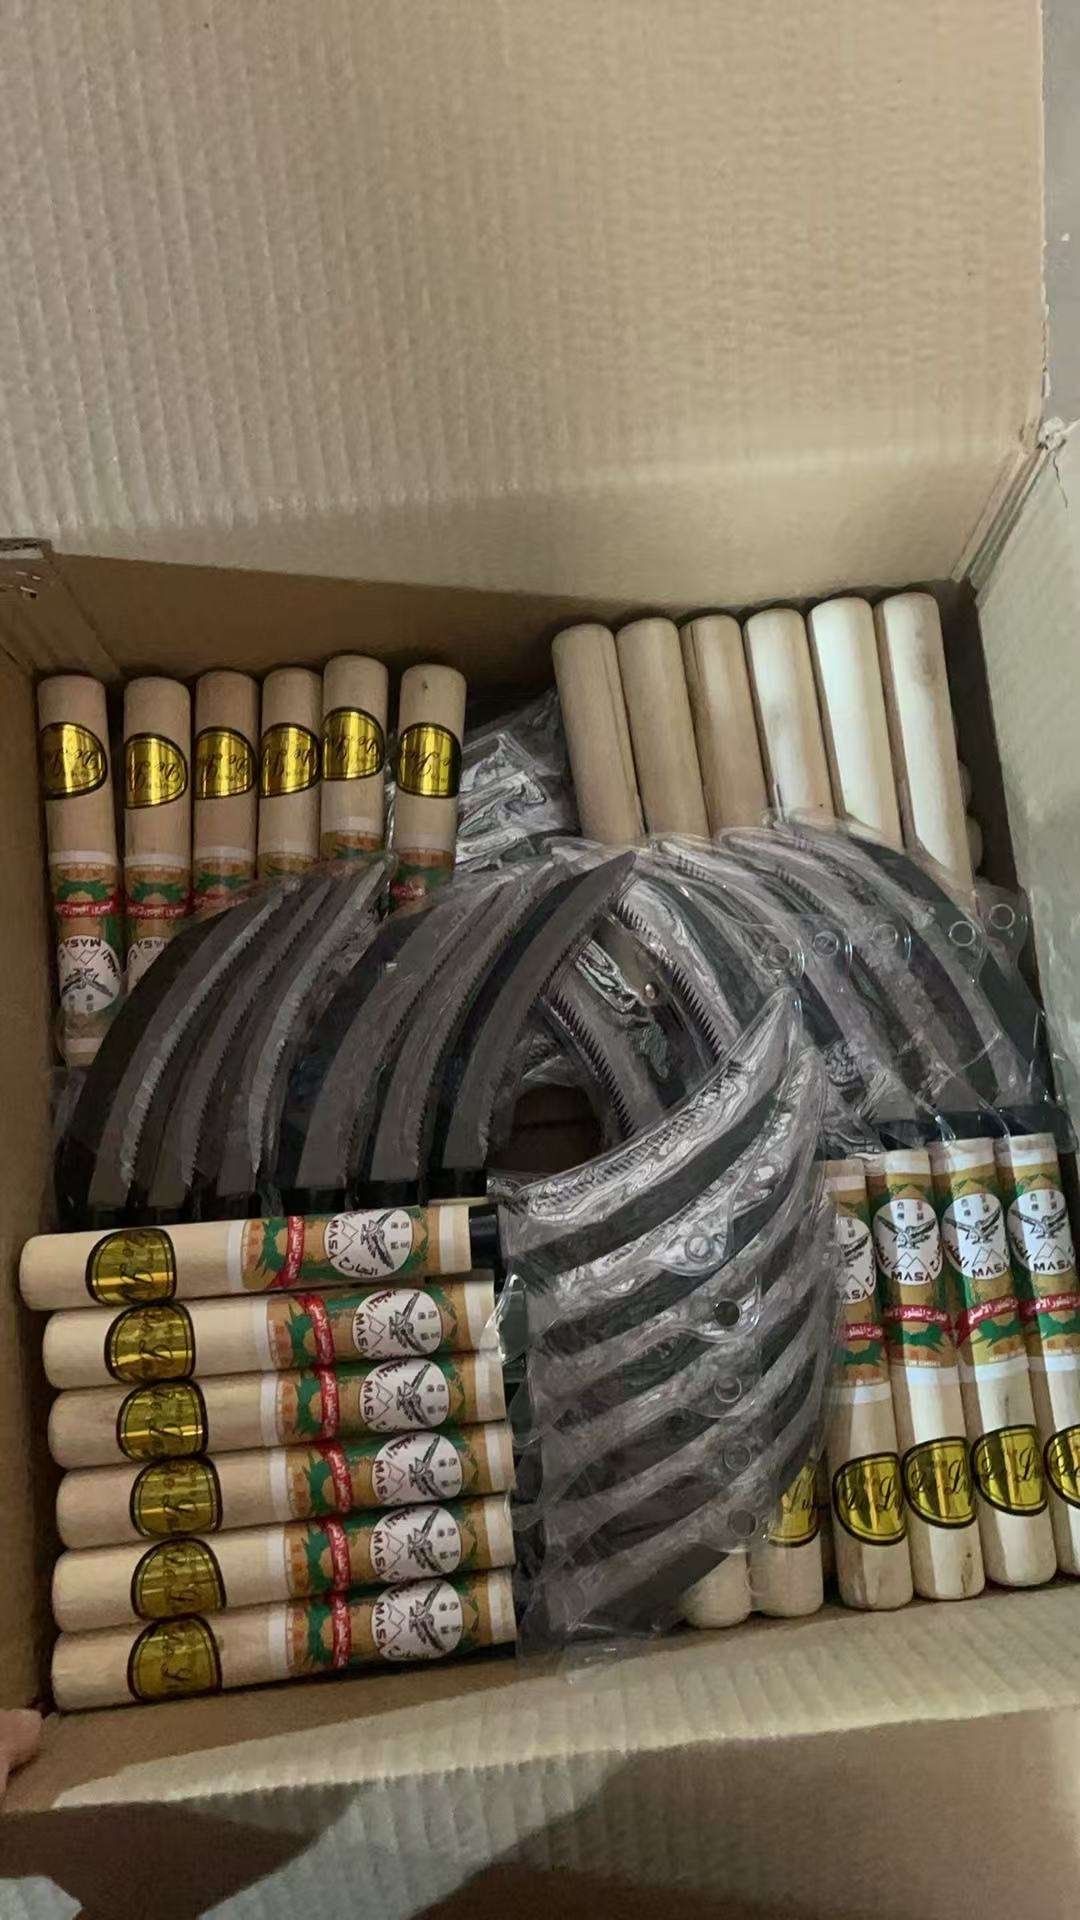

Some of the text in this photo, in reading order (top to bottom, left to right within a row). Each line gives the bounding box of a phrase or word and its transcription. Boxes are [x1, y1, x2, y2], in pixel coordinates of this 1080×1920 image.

[328, 1219, 339, 1260] MASA
[891, 1271, 933, 1281] MASA
[364, 1380, 374, 1425] MASA
